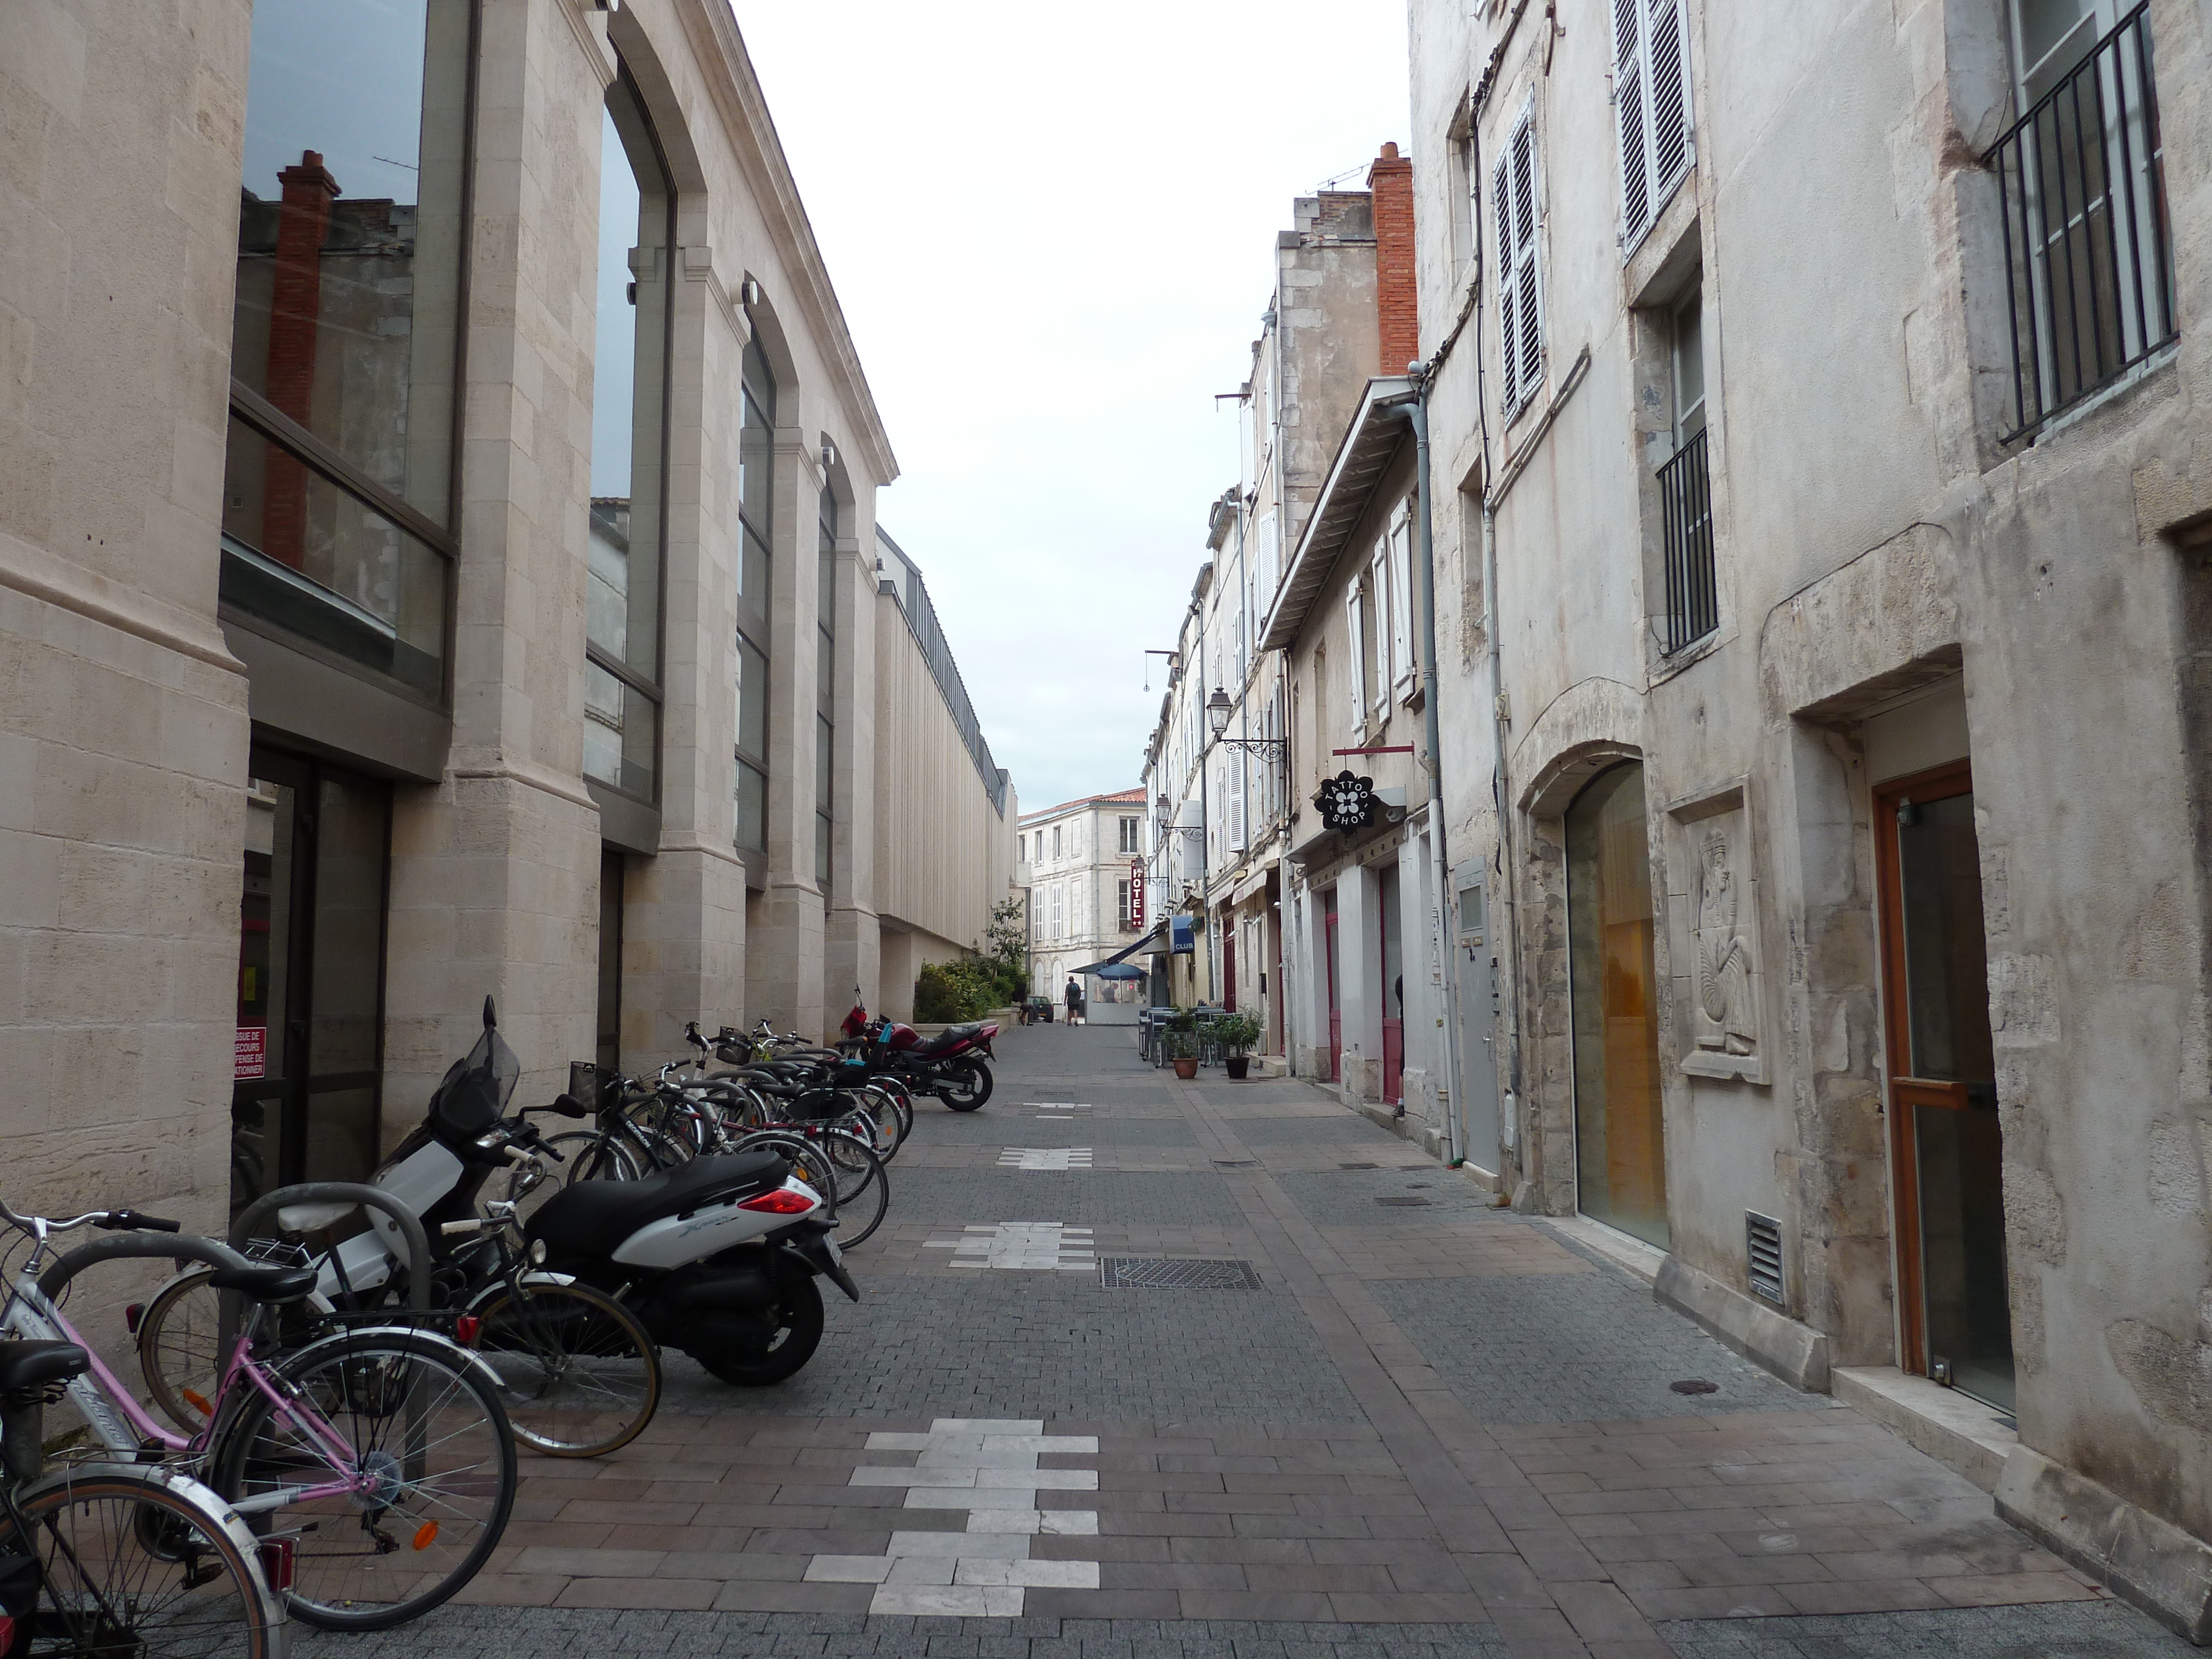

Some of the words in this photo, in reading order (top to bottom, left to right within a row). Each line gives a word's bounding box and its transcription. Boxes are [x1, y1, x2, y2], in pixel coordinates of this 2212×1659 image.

[1325, 781, 1368, 800] TATTOO
[1332, 811, 1365, 825] SHOP
[236, 1032, 251, 1041] SSUE
[252, 1031, 260, 1040] DE
[235, 1042, 260, 1052] ECOURS
[236, 1054, 254, 1063] FENSE
[255, 1053, 263, 1062] DE
[235, 1065, 263, 1074] ATIONNER
[625, 1120, 651, 1148] DECATHLON
